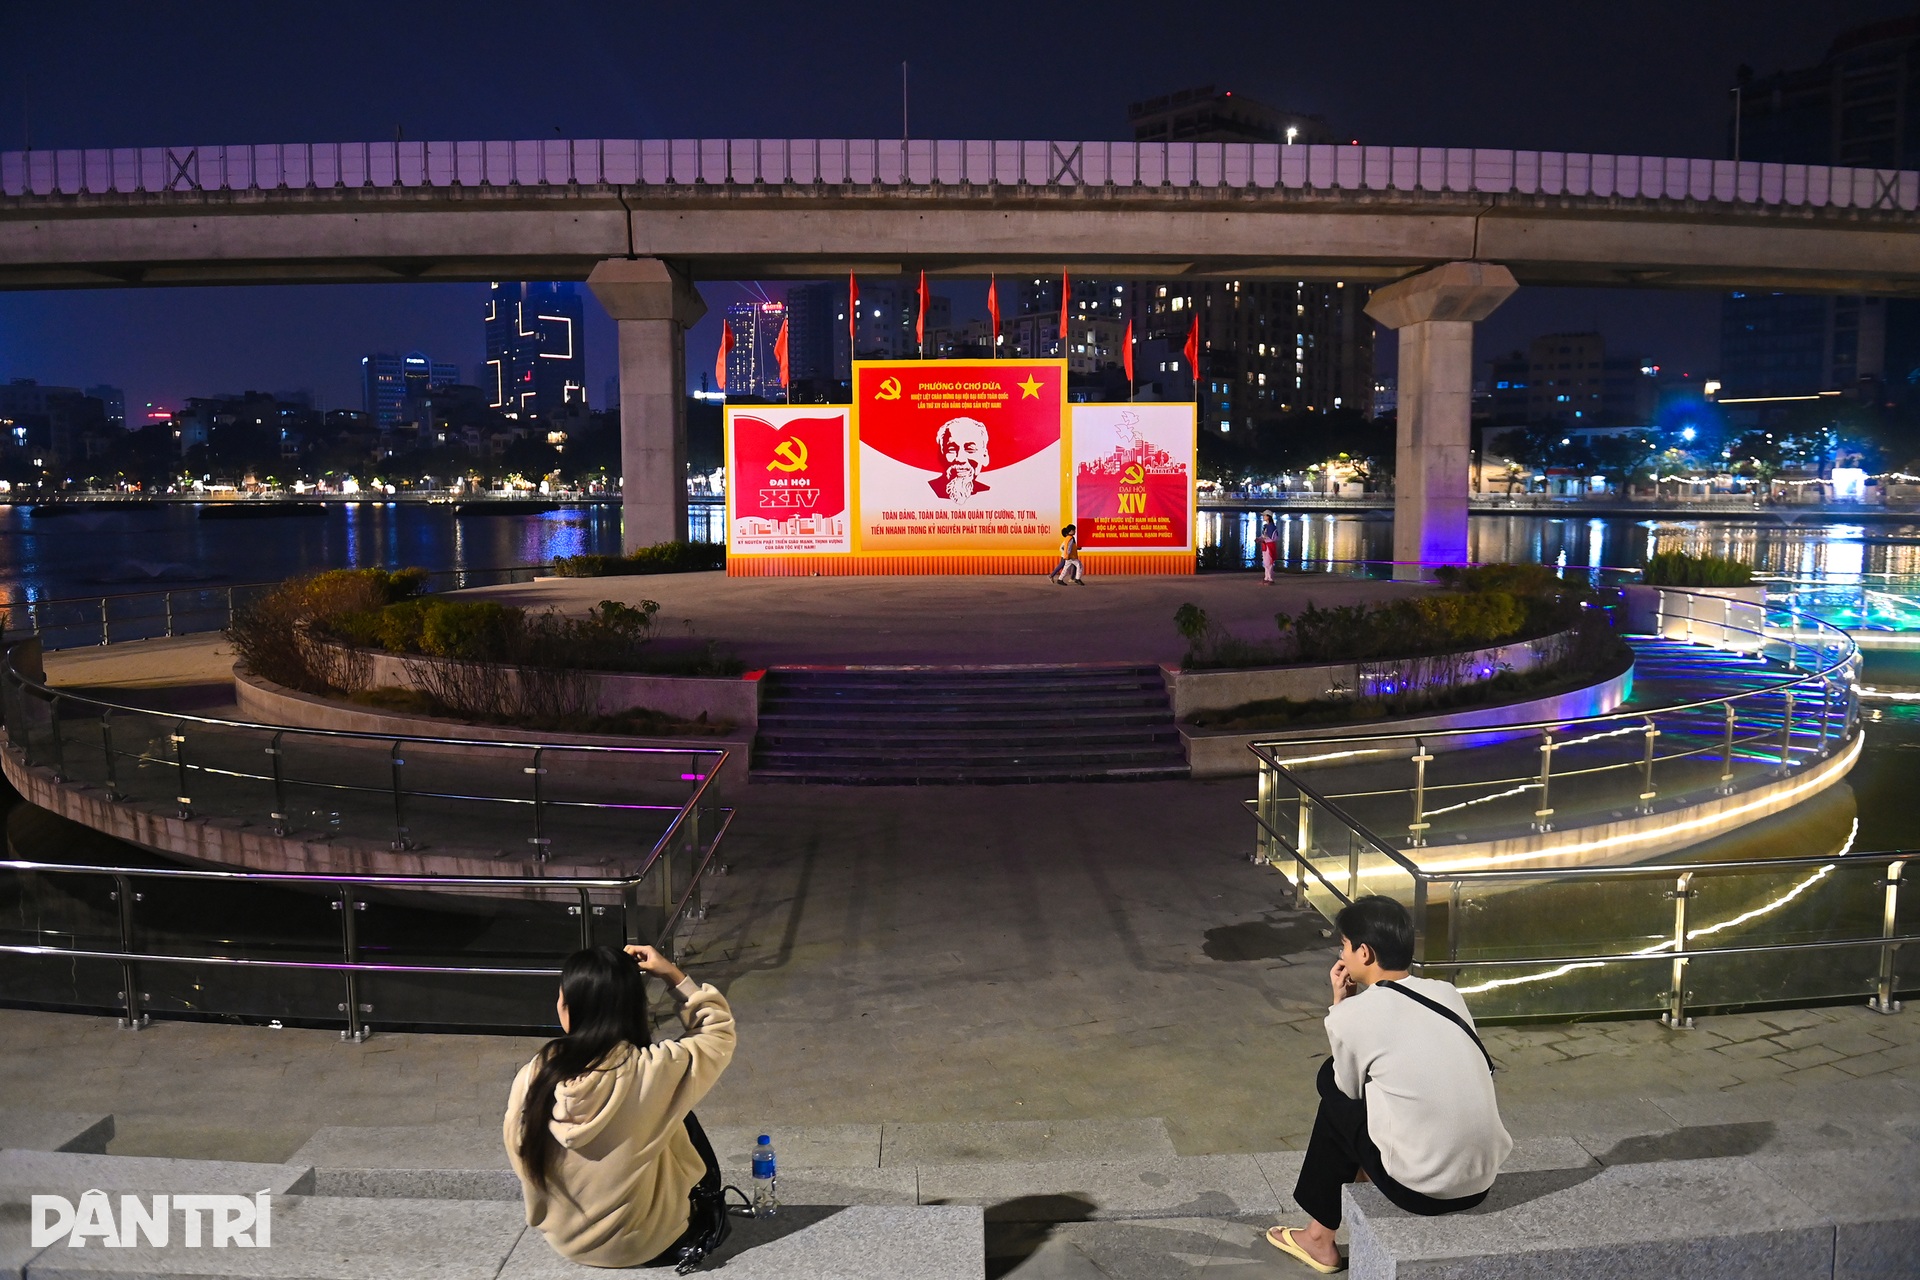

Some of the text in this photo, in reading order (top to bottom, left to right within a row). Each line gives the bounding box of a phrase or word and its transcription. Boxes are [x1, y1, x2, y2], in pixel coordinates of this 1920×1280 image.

[919, 381, 954, 390] PHƯỜNG
[963, 382, 981, 391] CHỢ
[982, 381, 1001, 390] DỪA
[769, 478, 810, 487] ĐẠI HỘI
[760, 488, 820, 508] XIV
[1118, 493, 1146, 513] XIV
[882, 509, 1037, 521] TOÀN ĐẢNG, TOÀN DÂN, TOÀN QUÂN TỰ CƯỜNG, TỰ TIN,
[871, 522, 1051, 536] TIẾN NHANH TRONG KỶ NGUYÊN PHÁT TRIỂN MỚI CỦA DÂN TỘC!
